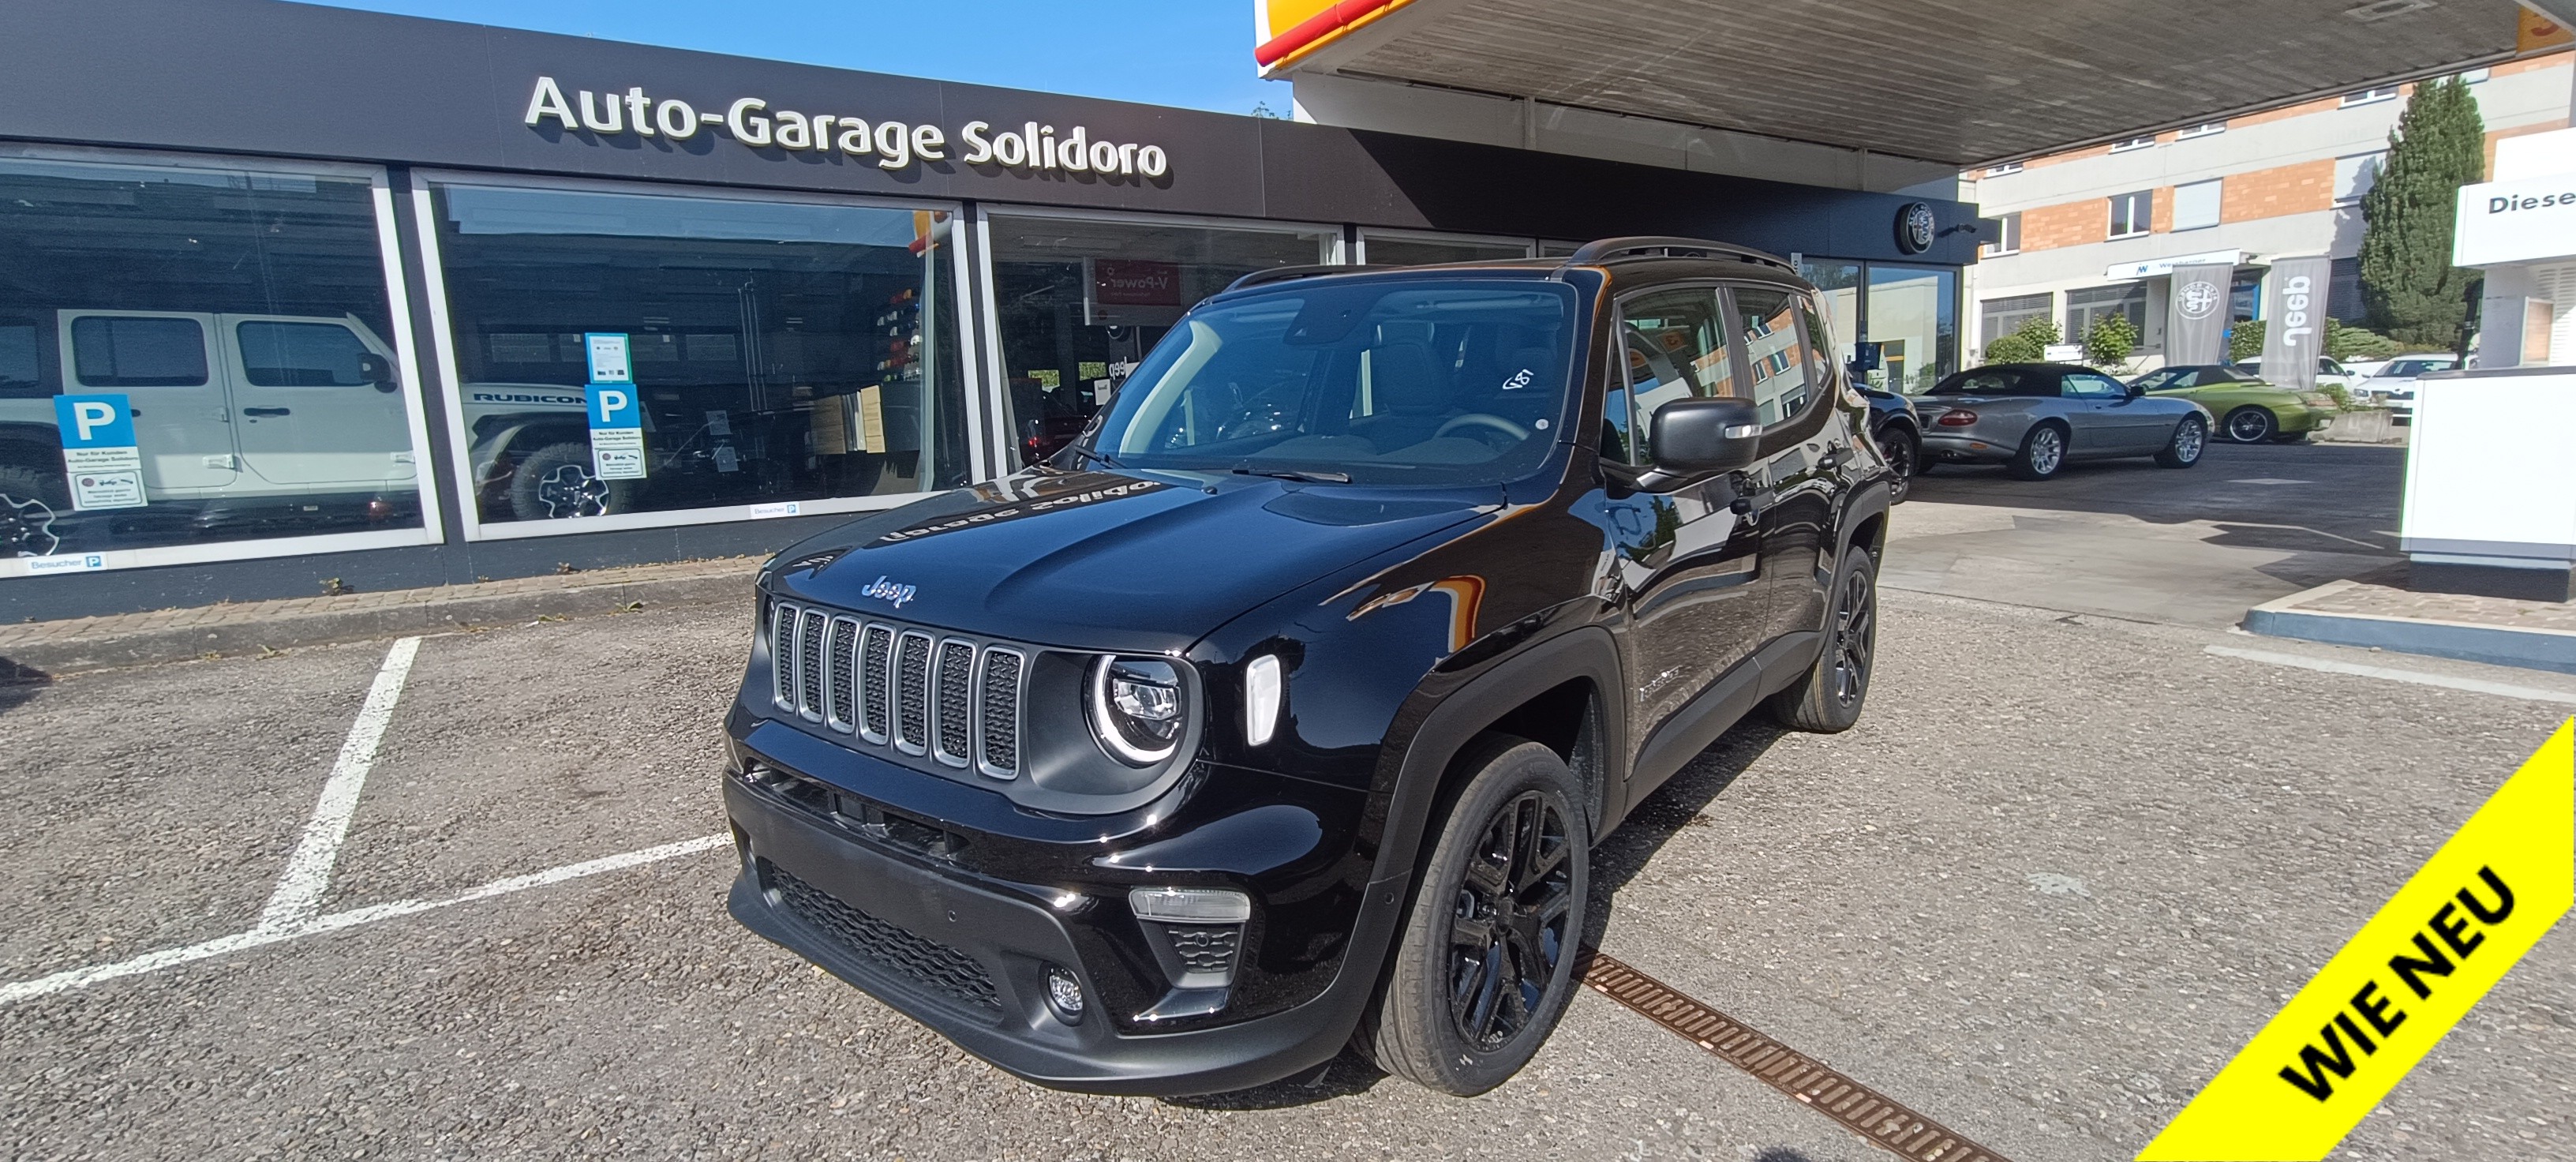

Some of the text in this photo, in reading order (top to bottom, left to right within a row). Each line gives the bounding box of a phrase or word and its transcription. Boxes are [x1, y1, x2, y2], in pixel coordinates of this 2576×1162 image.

[525, 77, 1167, 177] Auto-Garage Solidoro
[2488, 191, 2576, 214] Diese
[474, 393, 586, 403] RUBICON
[598, 390, 627, 422] P
[73, 402, 116, 440] P
[32, 560, 81, 569] Besucher
[861, 575, 916, 609] Jeep
